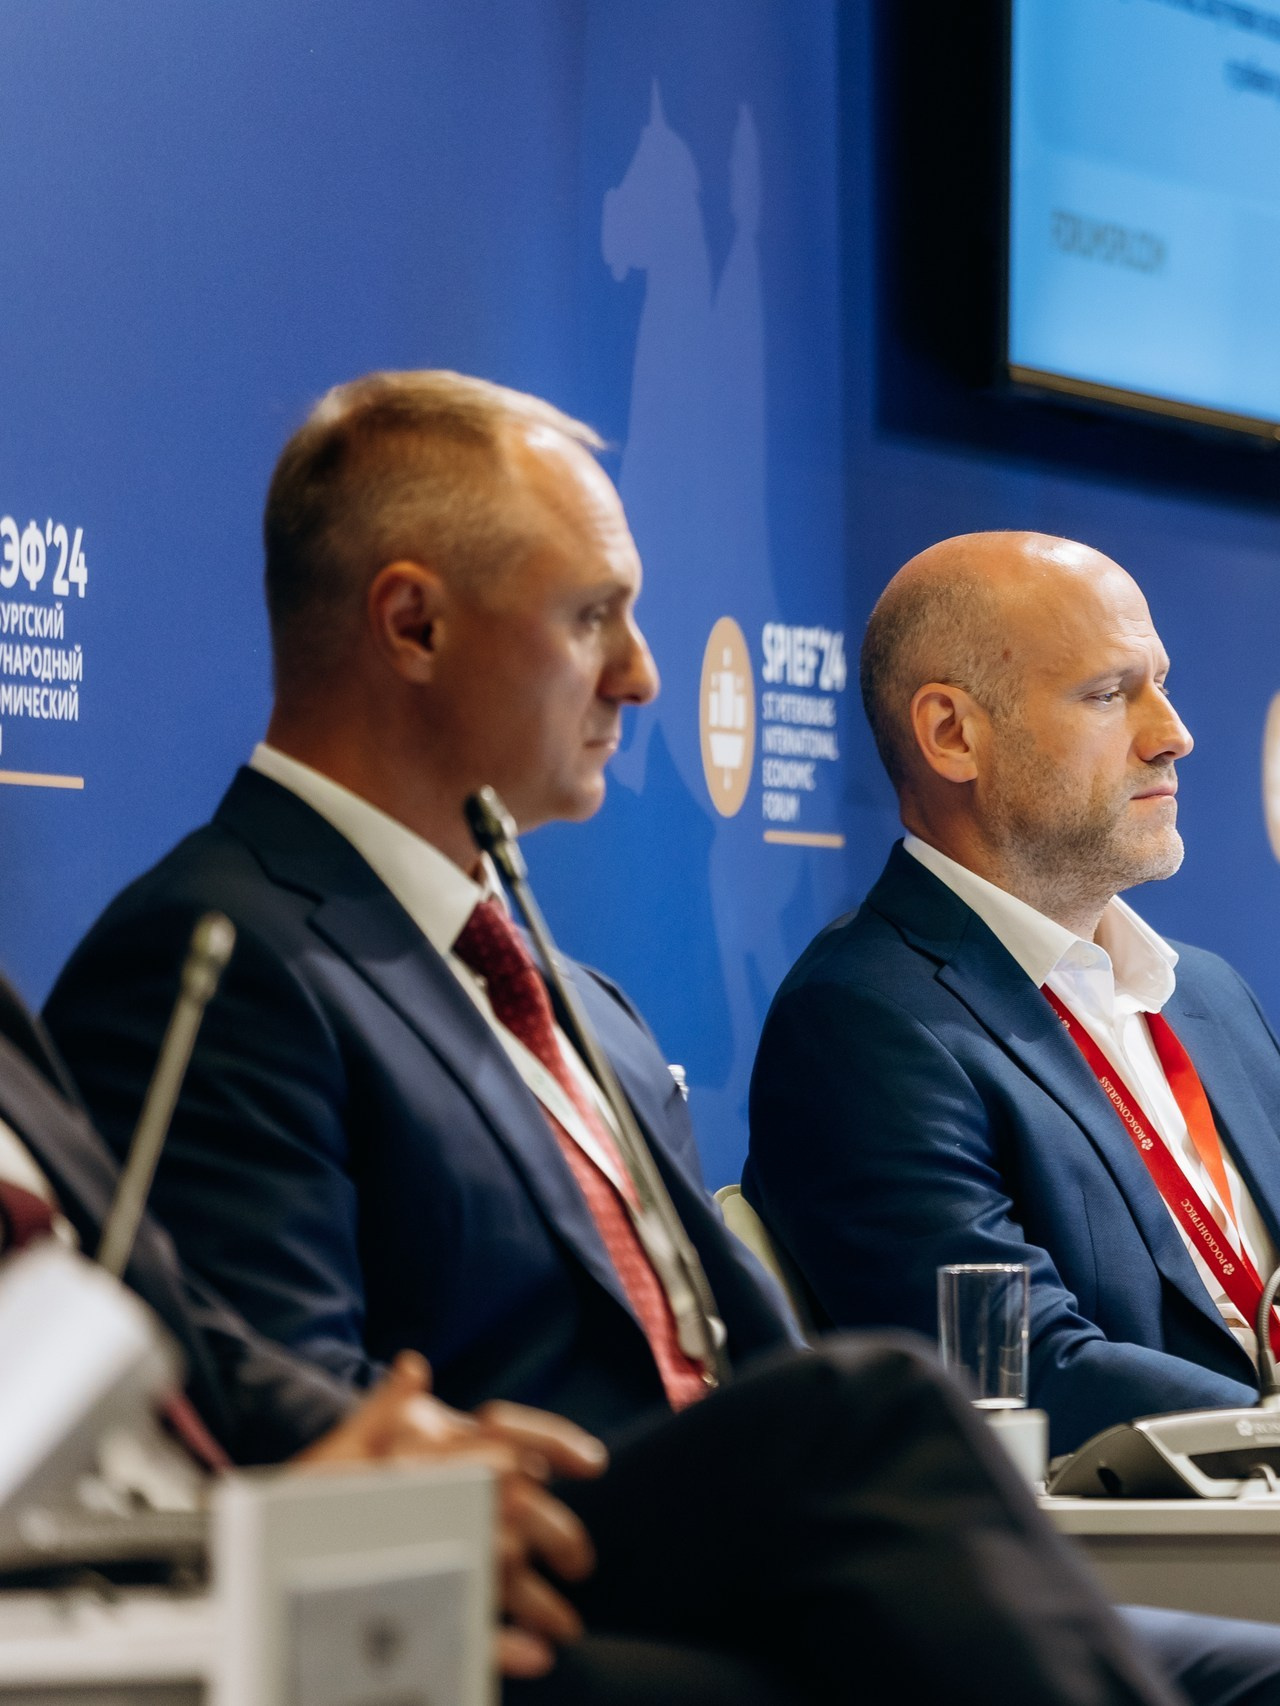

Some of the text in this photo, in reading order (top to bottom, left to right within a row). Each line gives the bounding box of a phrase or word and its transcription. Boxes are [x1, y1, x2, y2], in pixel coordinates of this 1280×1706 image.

[0, 602, 64, 640] УРГСКИЙ
[1100, 1076, 1146, 1141] ROSCONGRESS
[1181, 1198, 1228, 1265] РОСКОНГРЕСС
